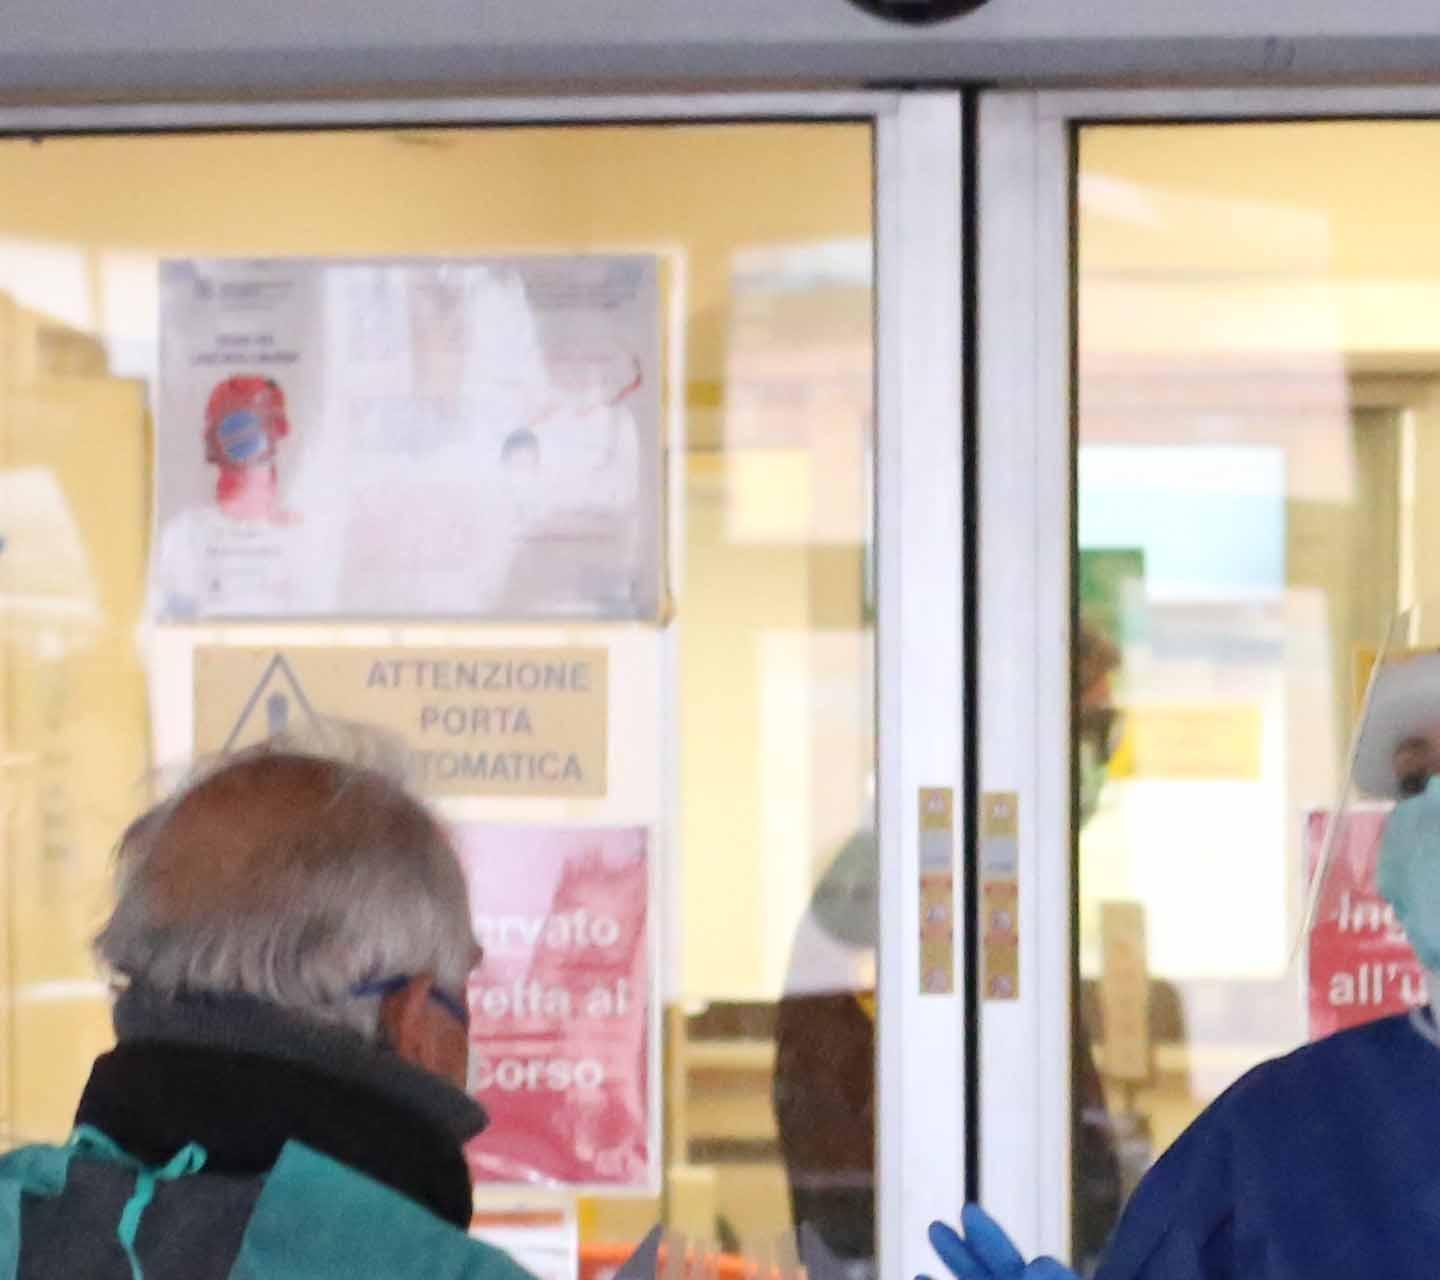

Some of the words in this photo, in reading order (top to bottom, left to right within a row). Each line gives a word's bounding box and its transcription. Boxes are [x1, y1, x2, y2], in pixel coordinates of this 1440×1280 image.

[366, 660, 590, 692] ATTENZIONE
[420, 706, 534, 737] PORTA
[420, 751, 584, 783] TOMATICA
[474, 910, 620, 947] ervato
[586, 977, 629, 1018] al
[1328, 961, 1427, 1007] all'u
